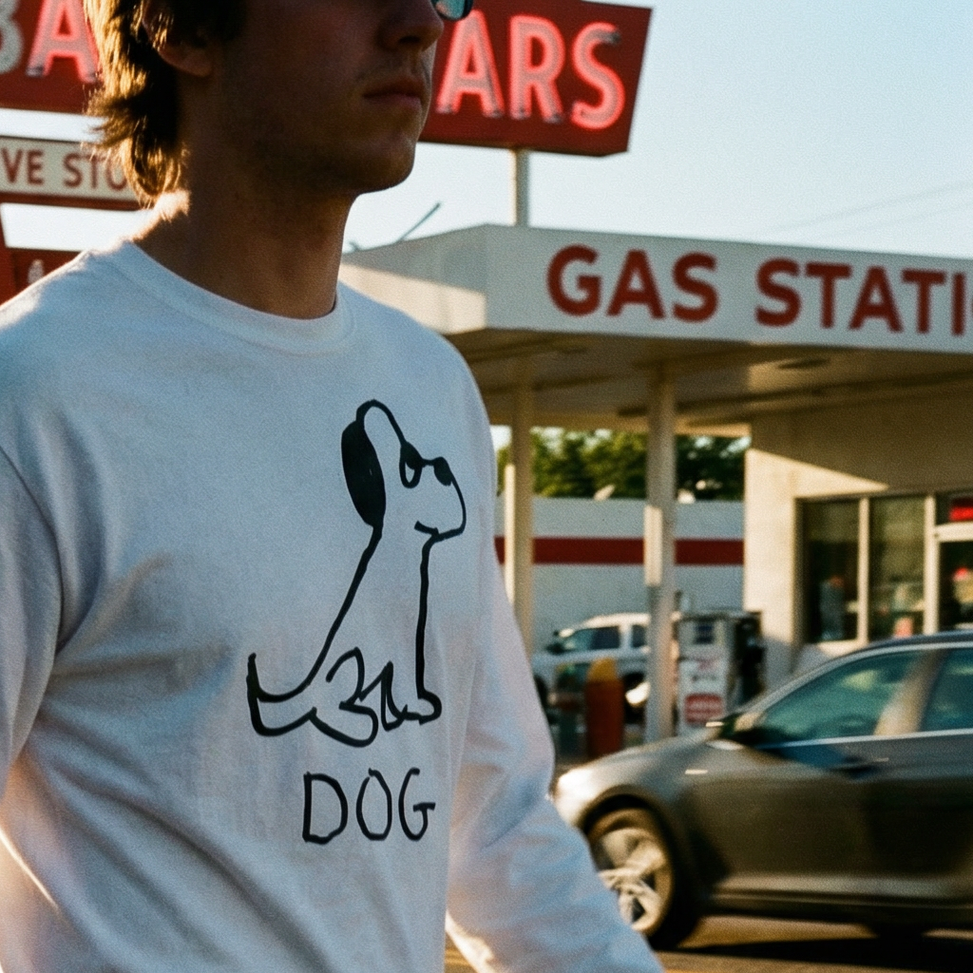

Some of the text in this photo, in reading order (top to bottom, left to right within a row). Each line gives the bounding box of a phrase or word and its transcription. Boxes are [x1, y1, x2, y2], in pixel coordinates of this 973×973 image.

[546, 243, 973, 337] GAS STATI
[302, 767, 437, 845] DOG
